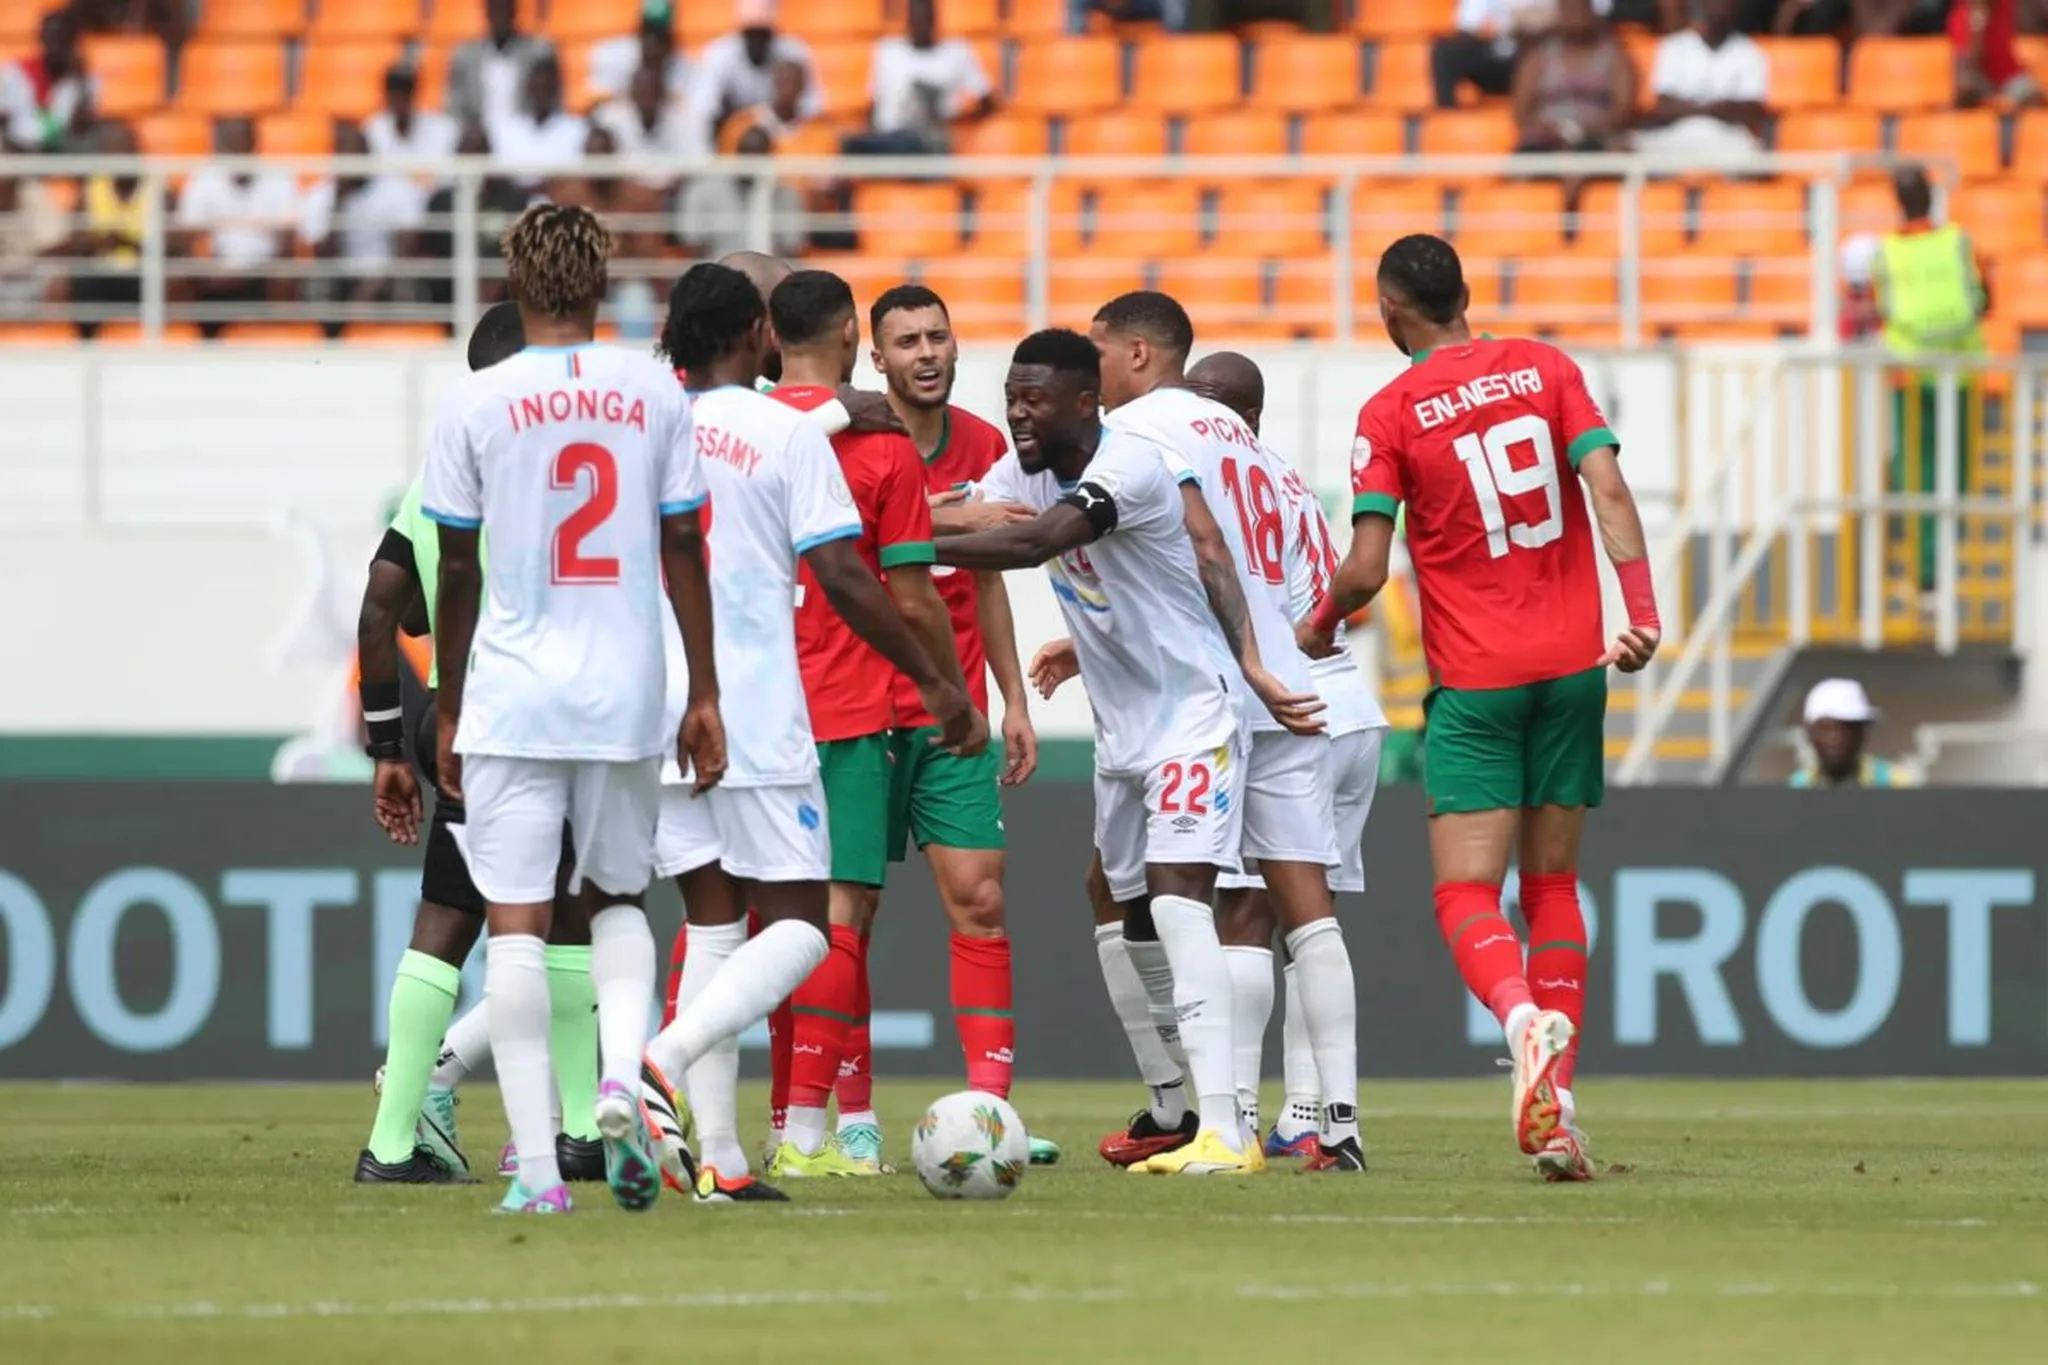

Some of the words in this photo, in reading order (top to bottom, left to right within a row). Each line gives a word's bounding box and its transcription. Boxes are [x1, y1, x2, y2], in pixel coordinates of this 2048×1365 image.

[509, 389, 646, 434] INONGA
[1414, 366, 1543, 429] EN-NESYRI
[695, 424, 763, 478] SSAMY
[1190, 416, 1261, 454] PICKE
[549, 441, 620, 586] 2
[1453, 413, 1563, 559] 19
[1220, 456, 1285, 586] 18
[1160, 762, 1210, 815] 22
